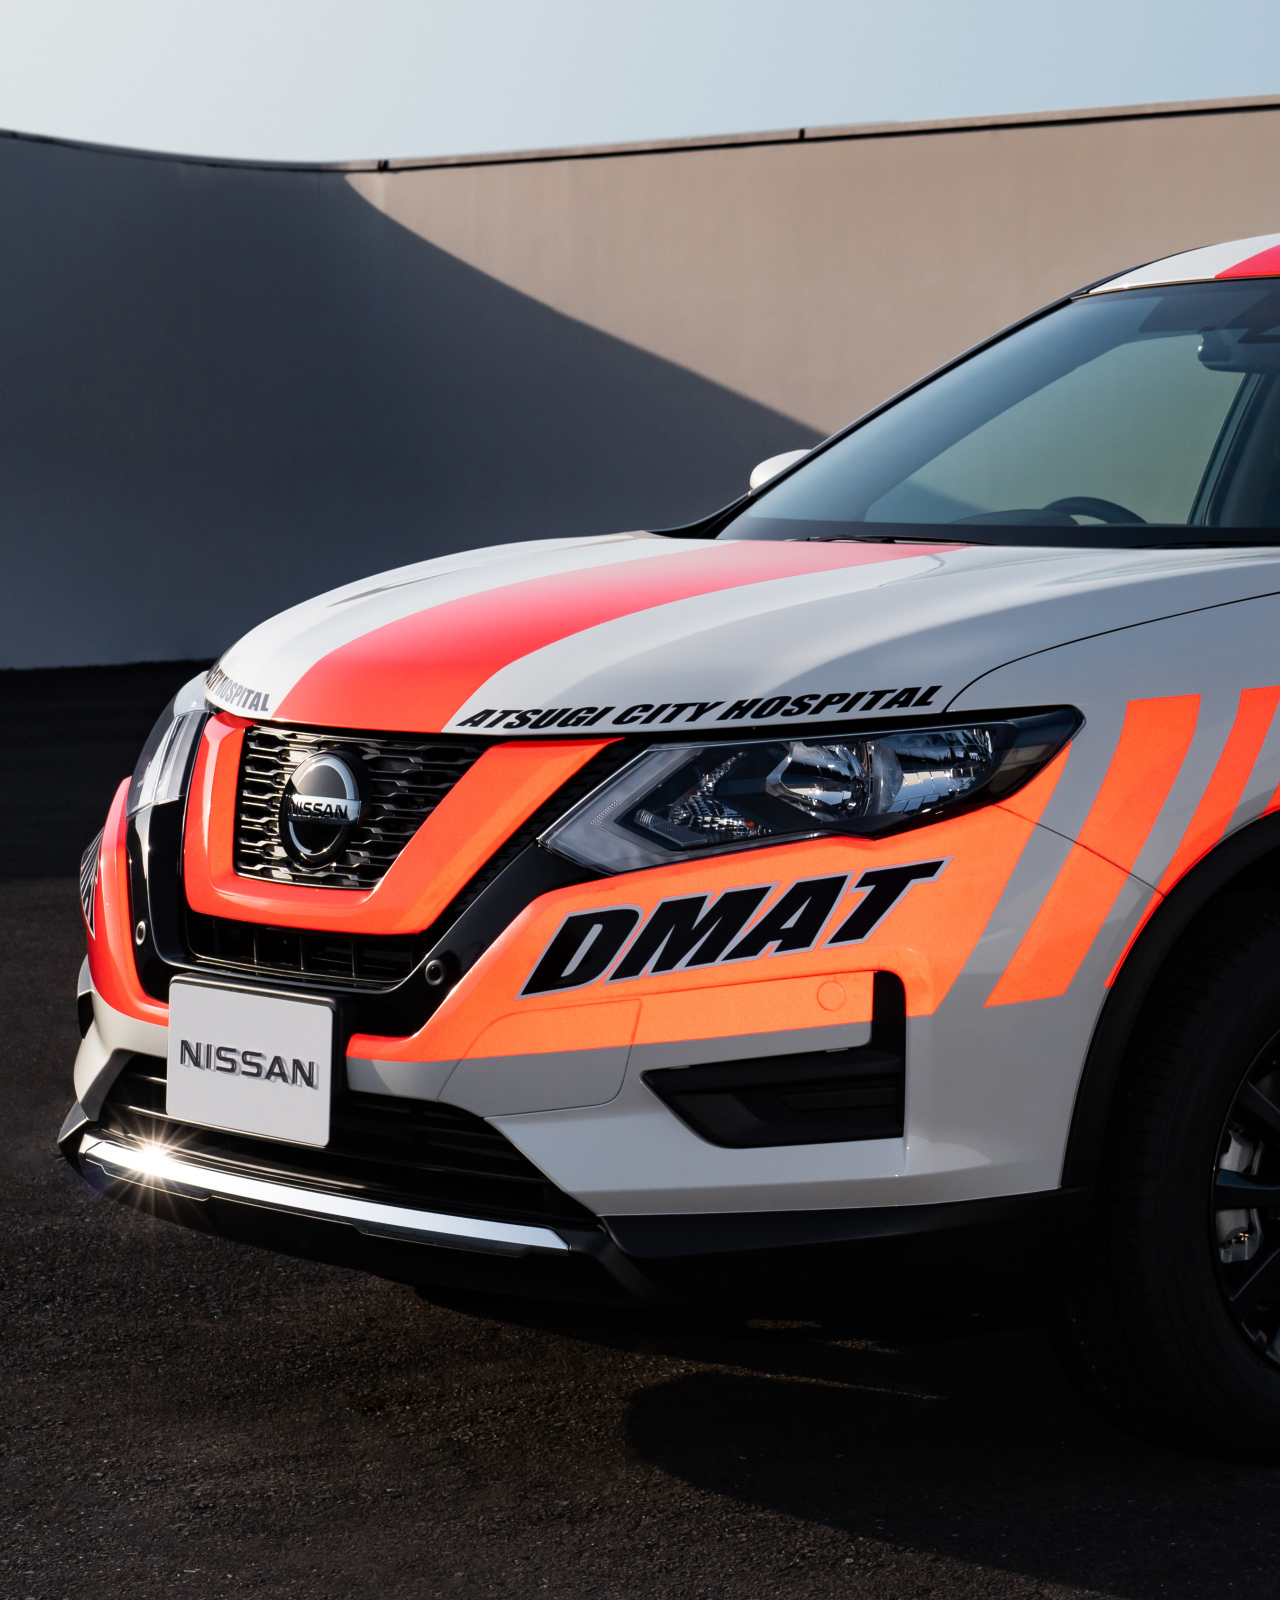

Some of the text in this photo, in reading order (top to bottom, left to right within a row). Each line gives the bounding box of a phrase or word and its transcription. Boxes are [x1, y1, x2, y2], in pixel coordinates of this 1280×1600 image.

[215, 676, 270, 712] HOSPITAL
[457, 685, 943, 731] ATSUGI CITY HOSPITAL
[288, 800, 349, 819] NISSAN
[516, 857, 953, 999] DMAT
[180, 1040, 318, 1088] NISSAN
